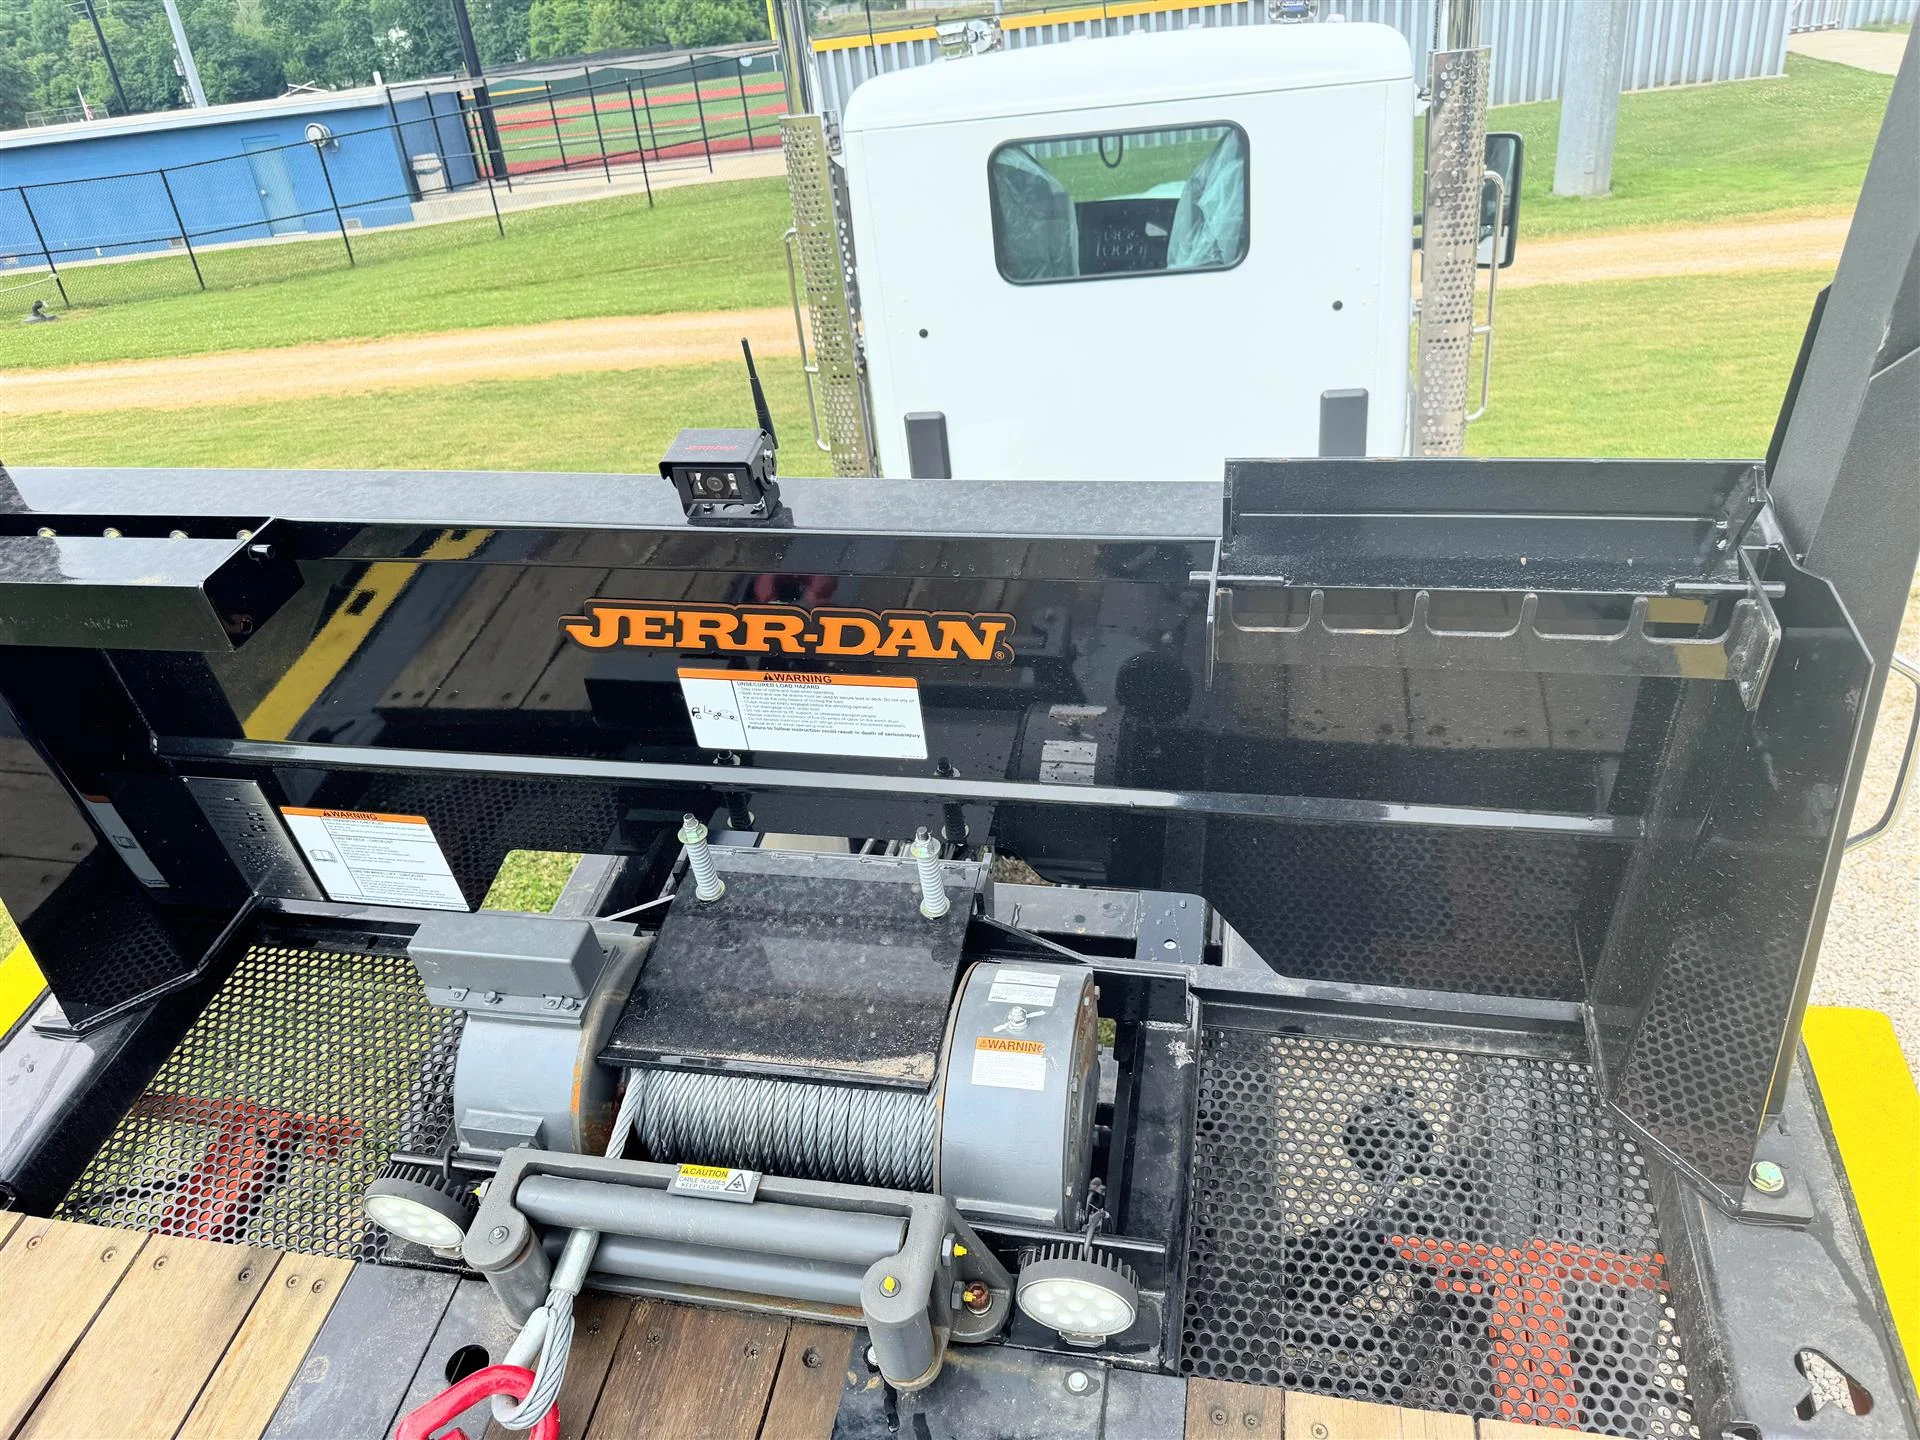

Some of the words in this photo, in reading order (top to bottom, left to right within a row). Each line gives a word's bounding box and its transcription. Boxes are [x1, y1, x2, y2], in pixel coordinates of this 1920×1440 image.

[565, 608, 1006, 661] JERR-DAN
[773, 673, 832, 684] WARNING
[330, 810, 378, 820] WARNING
[690, 1168, 728, 1178] CAUTION
